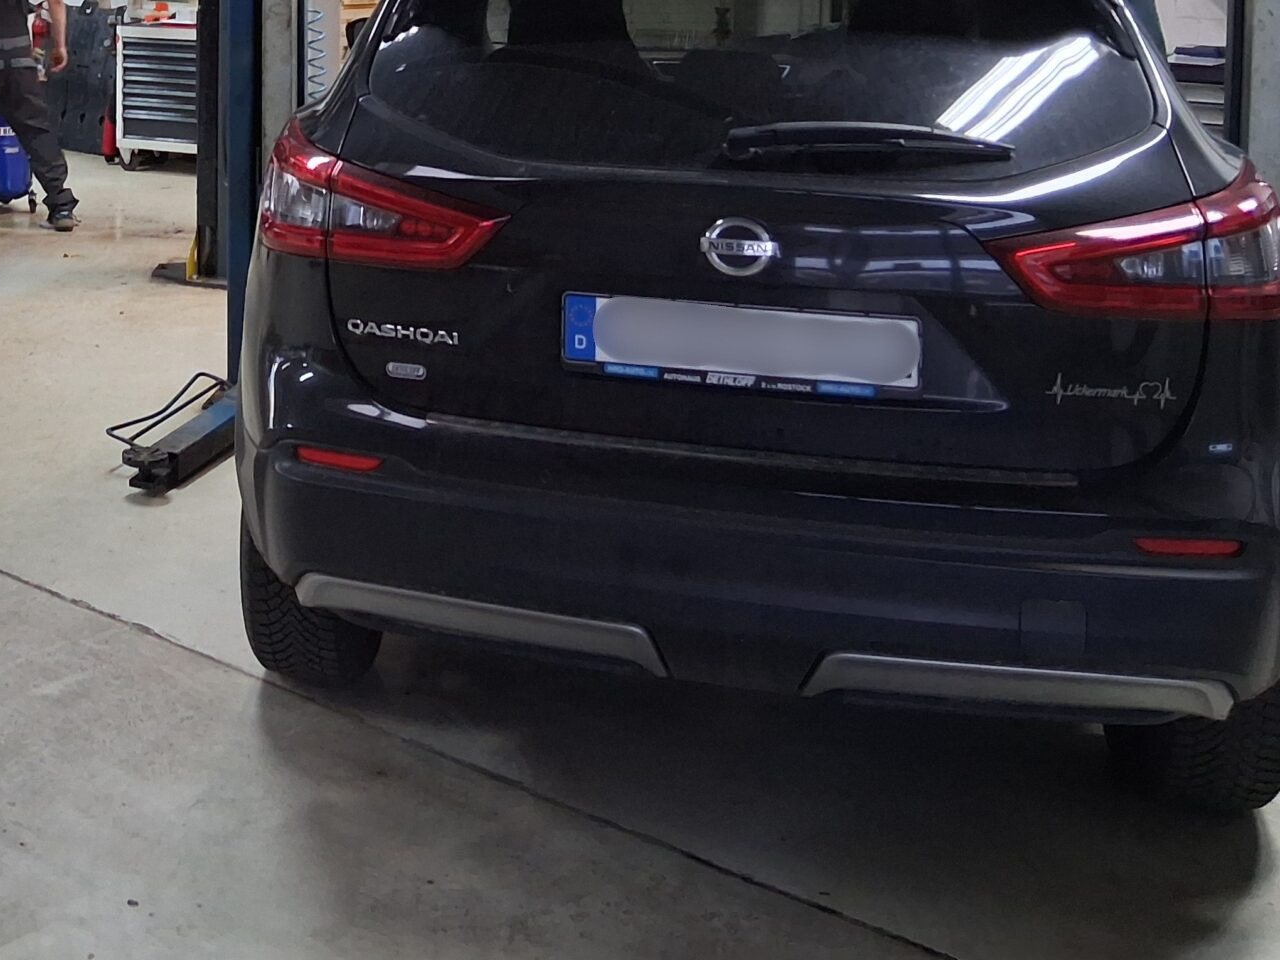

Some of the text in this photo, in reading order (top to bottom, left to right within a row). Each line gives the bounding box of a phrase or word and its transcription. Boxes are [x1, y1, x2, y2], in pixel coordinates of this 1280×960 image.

[708, 240, 768, 253] NISSAN
[346, 318, 460, 346] QASHQAI
[574, 334, 587, 349] D
[705, 372, 756, 388] DETHLOFF
